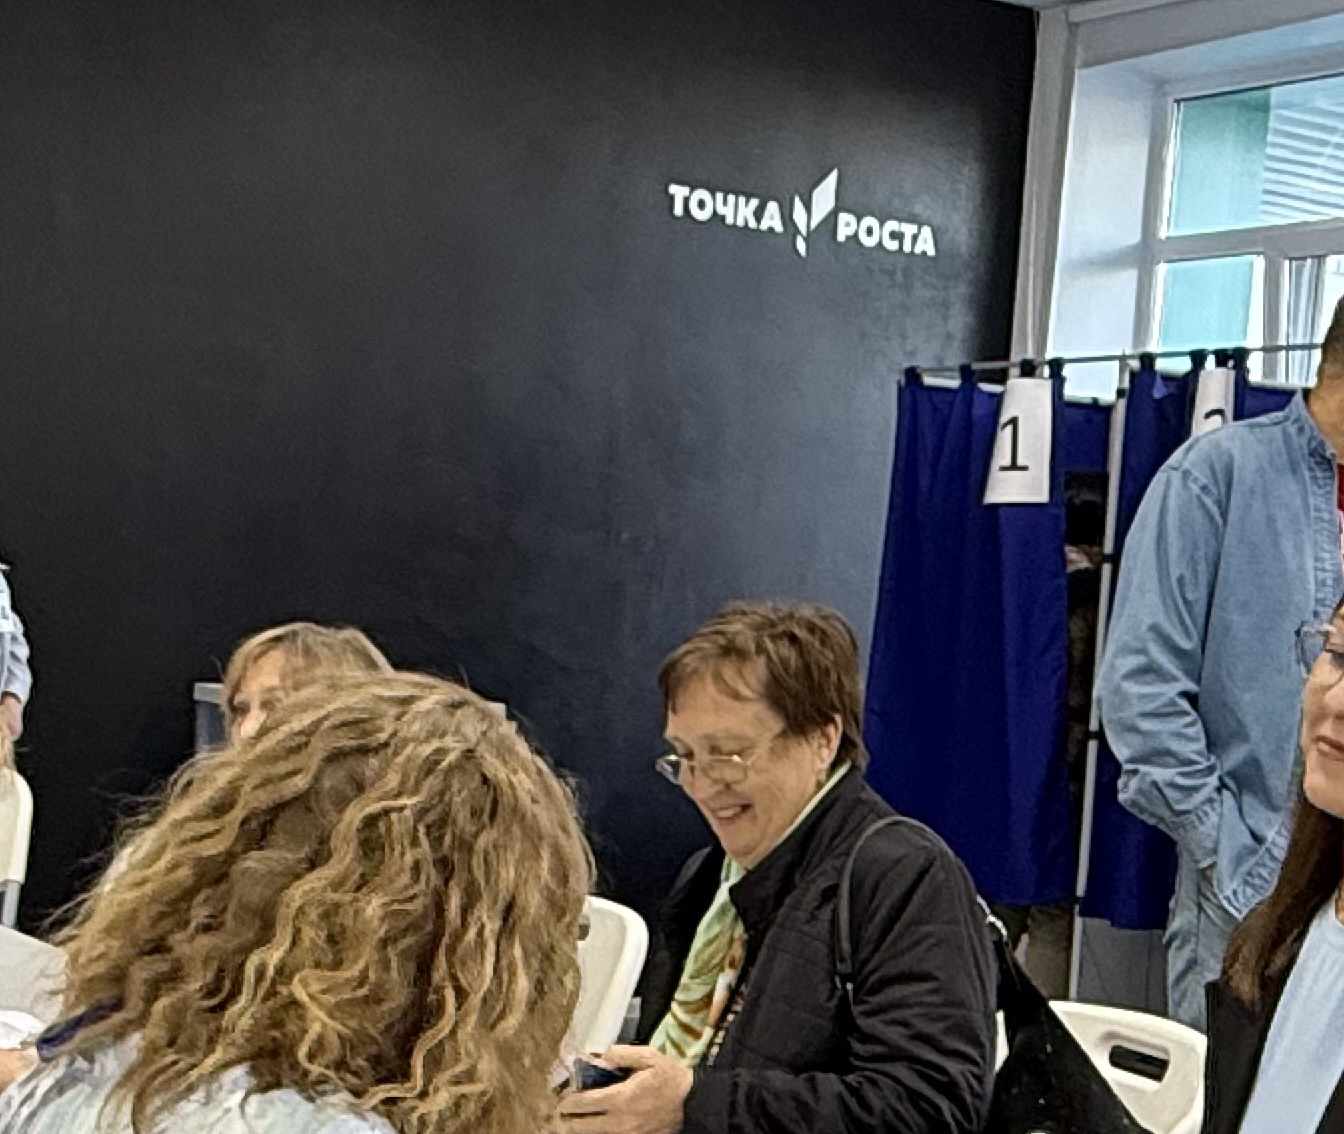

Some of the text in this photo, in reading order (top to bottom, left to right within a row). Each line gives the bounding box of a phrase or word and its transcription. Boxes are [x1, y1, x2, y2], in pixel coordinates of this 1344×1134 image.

[668, 182, 936, 257] ТОЧКА РОСТА
[998, 415, 1030, 472] 1
